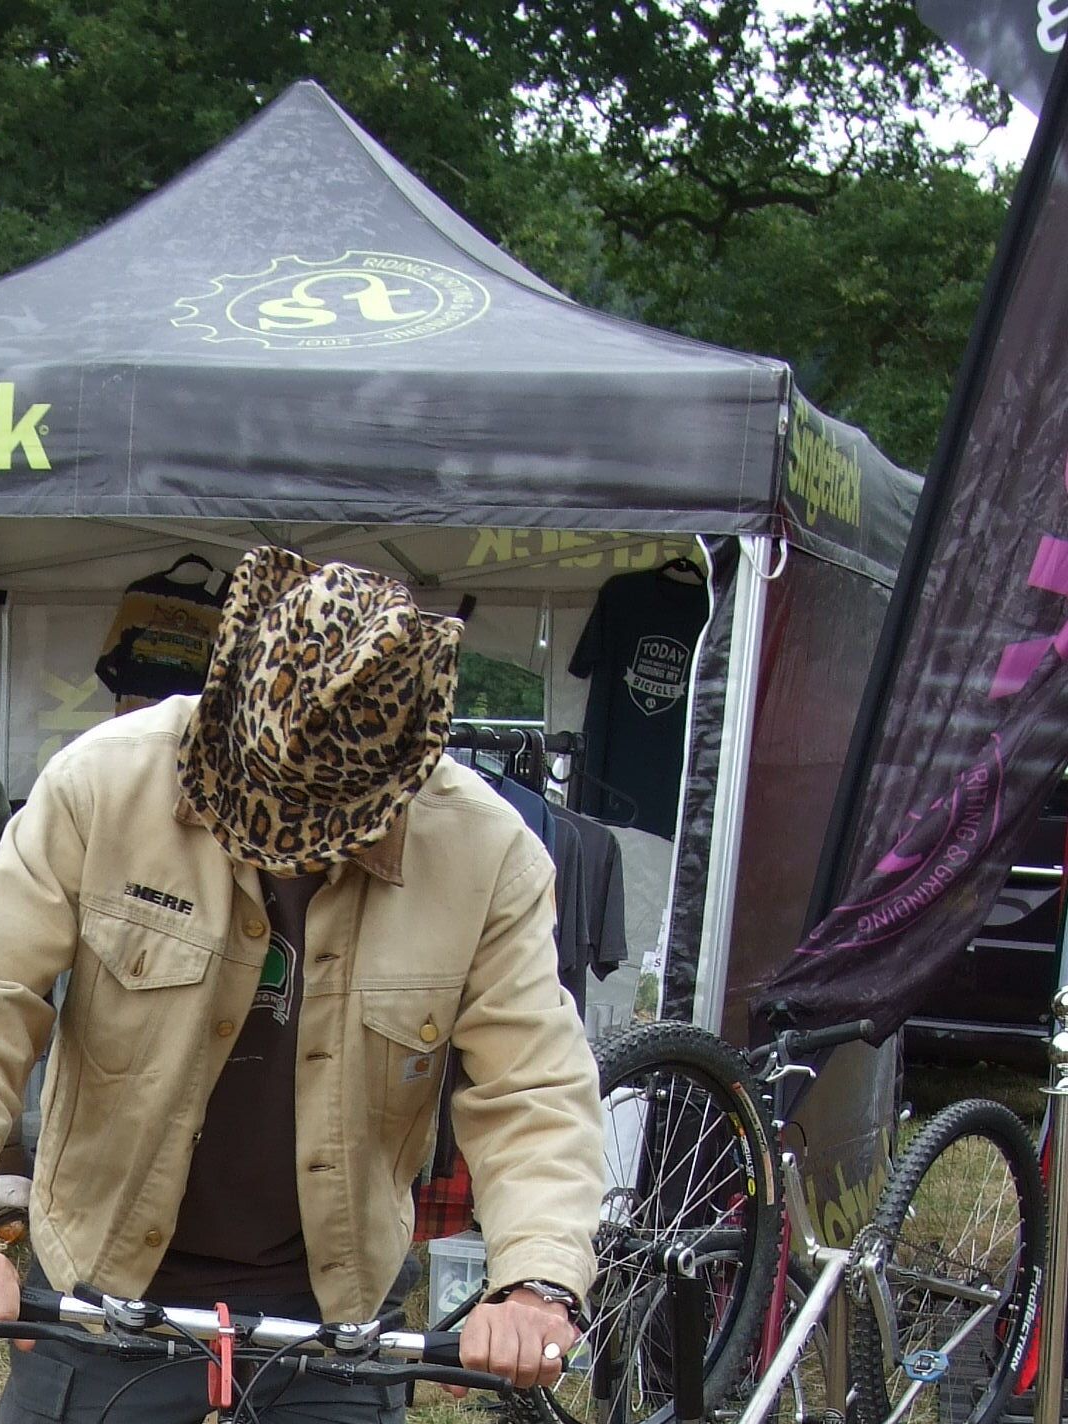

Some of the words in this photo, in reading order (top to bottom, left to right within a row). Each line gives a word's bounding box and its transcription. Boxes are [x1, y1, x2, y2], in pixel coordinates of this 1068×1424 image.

[788, 402, 862, 527] Singletrack
[633, 676, 677, 695] BICYCLE
[642, 642, 685, 664] TODAY
[957, 763, 988, 841] RITING
[857, 864, 955, 933] GRINDING
